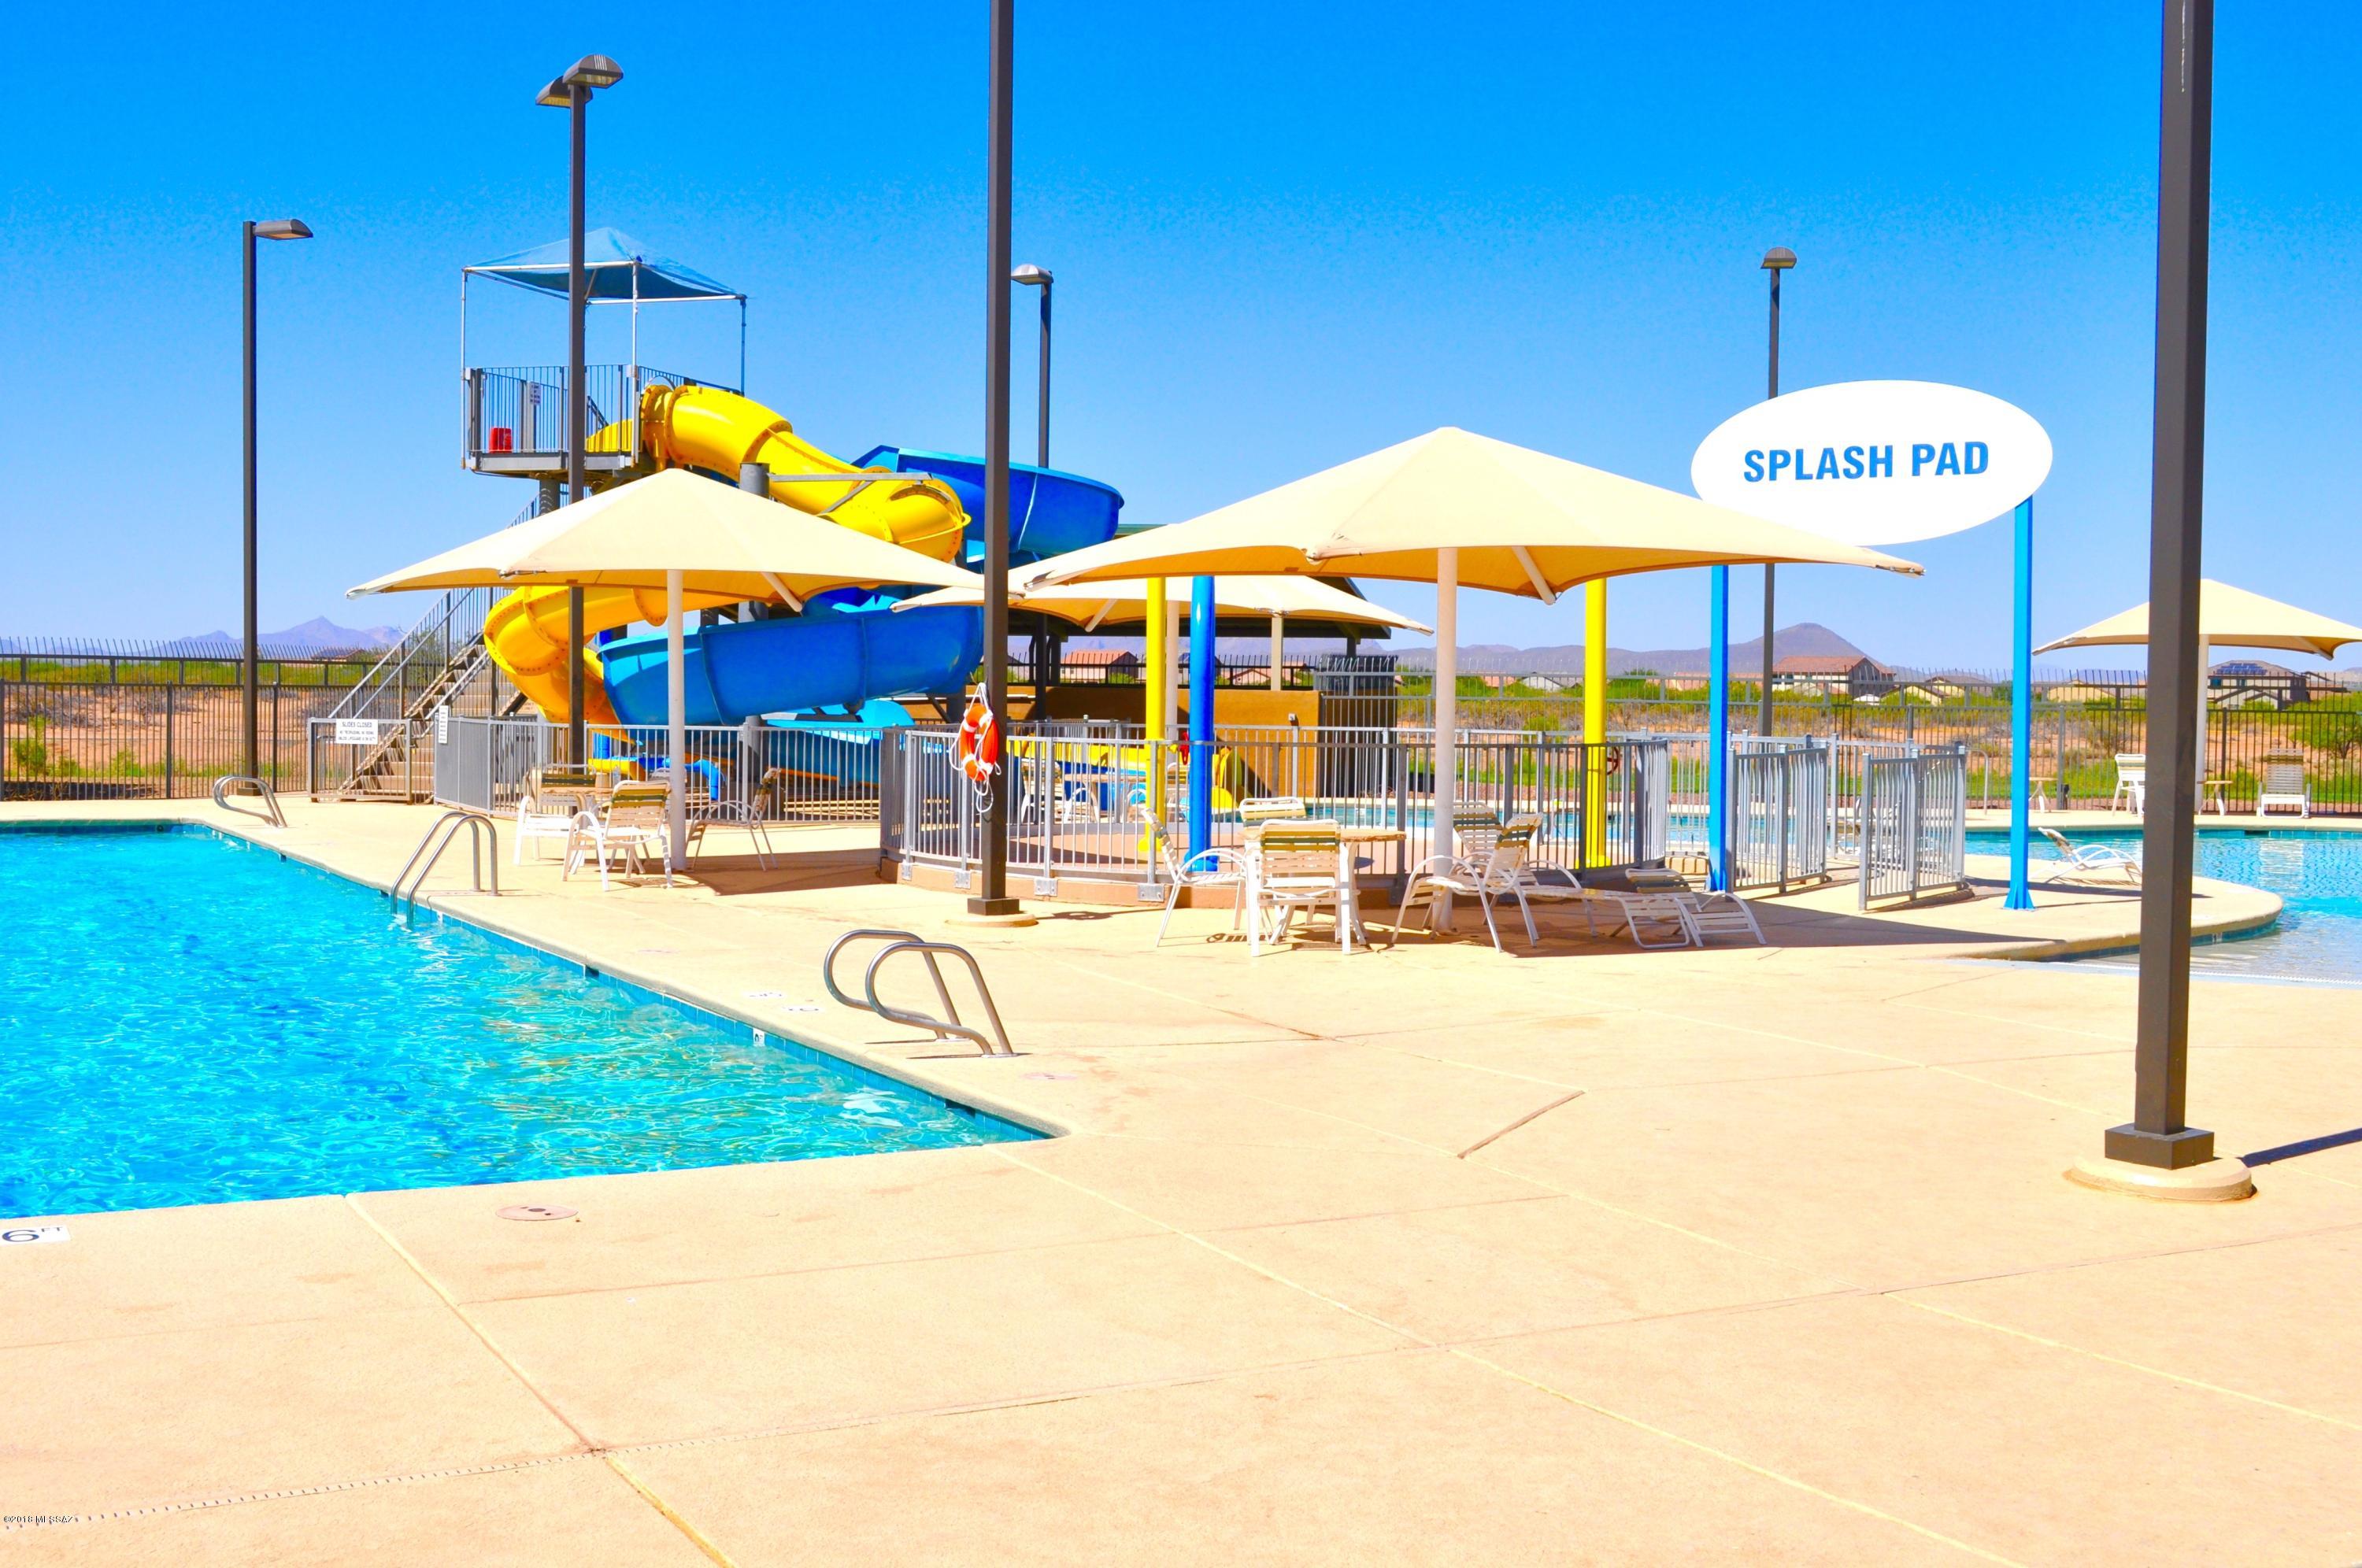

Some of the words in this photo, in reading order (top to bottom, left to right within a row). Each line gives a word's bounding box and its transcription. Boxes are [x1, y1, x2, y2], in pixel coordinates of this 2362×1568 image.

[1743, 445, 1894, 483] SPLASH
[1912, 441, 1989, 476] PAD
[2, 1230, 39, 1242] 6
